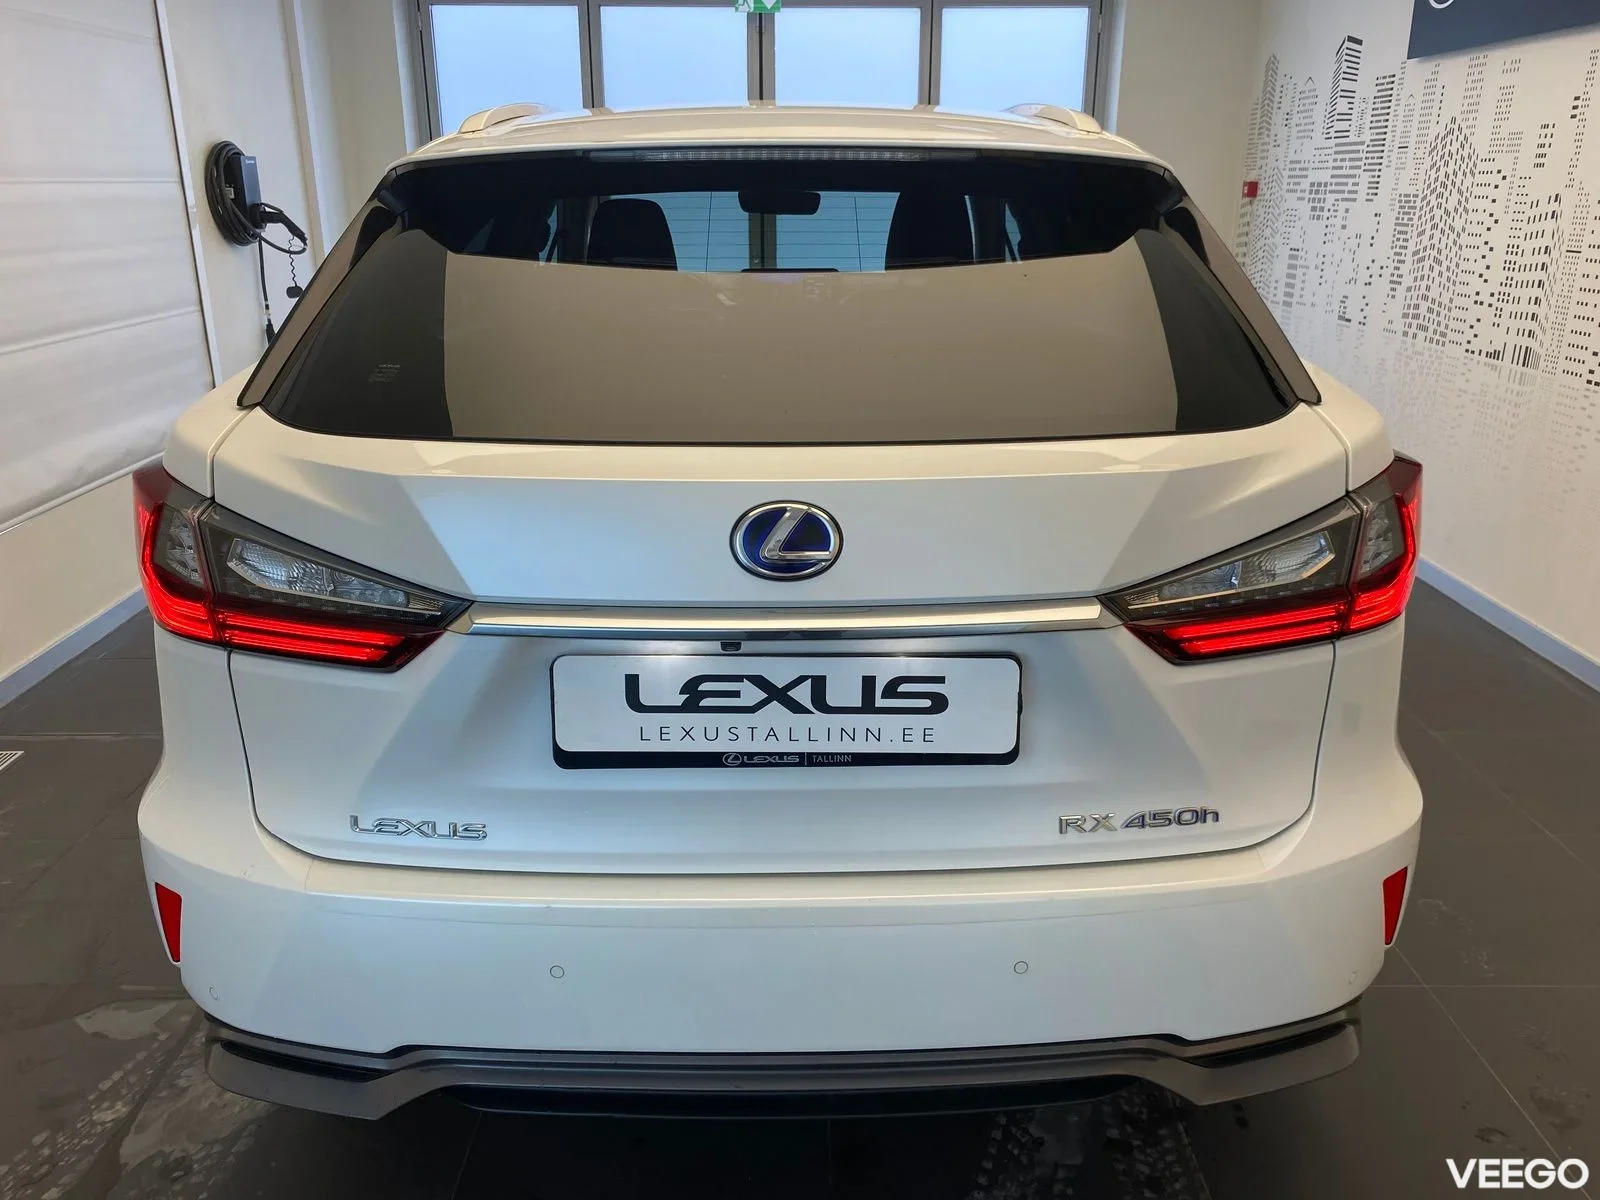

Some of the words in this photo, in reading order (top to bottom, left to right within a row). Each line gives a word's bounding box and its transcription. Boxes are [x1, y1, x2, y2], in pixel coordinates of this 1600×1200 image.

[624, 673, 949, 715] LEXUS
[639, 726, 935, 743] LEXUSTALLINN.EE
[743, 755, 800, 763] LEXUS
[812, 754, 852, 763] TALLINN
[350, 814, 487, 841] LEXUS
[1058, 812, 1118, 834] RX
[1120, 805, 1219, 830] 450h
